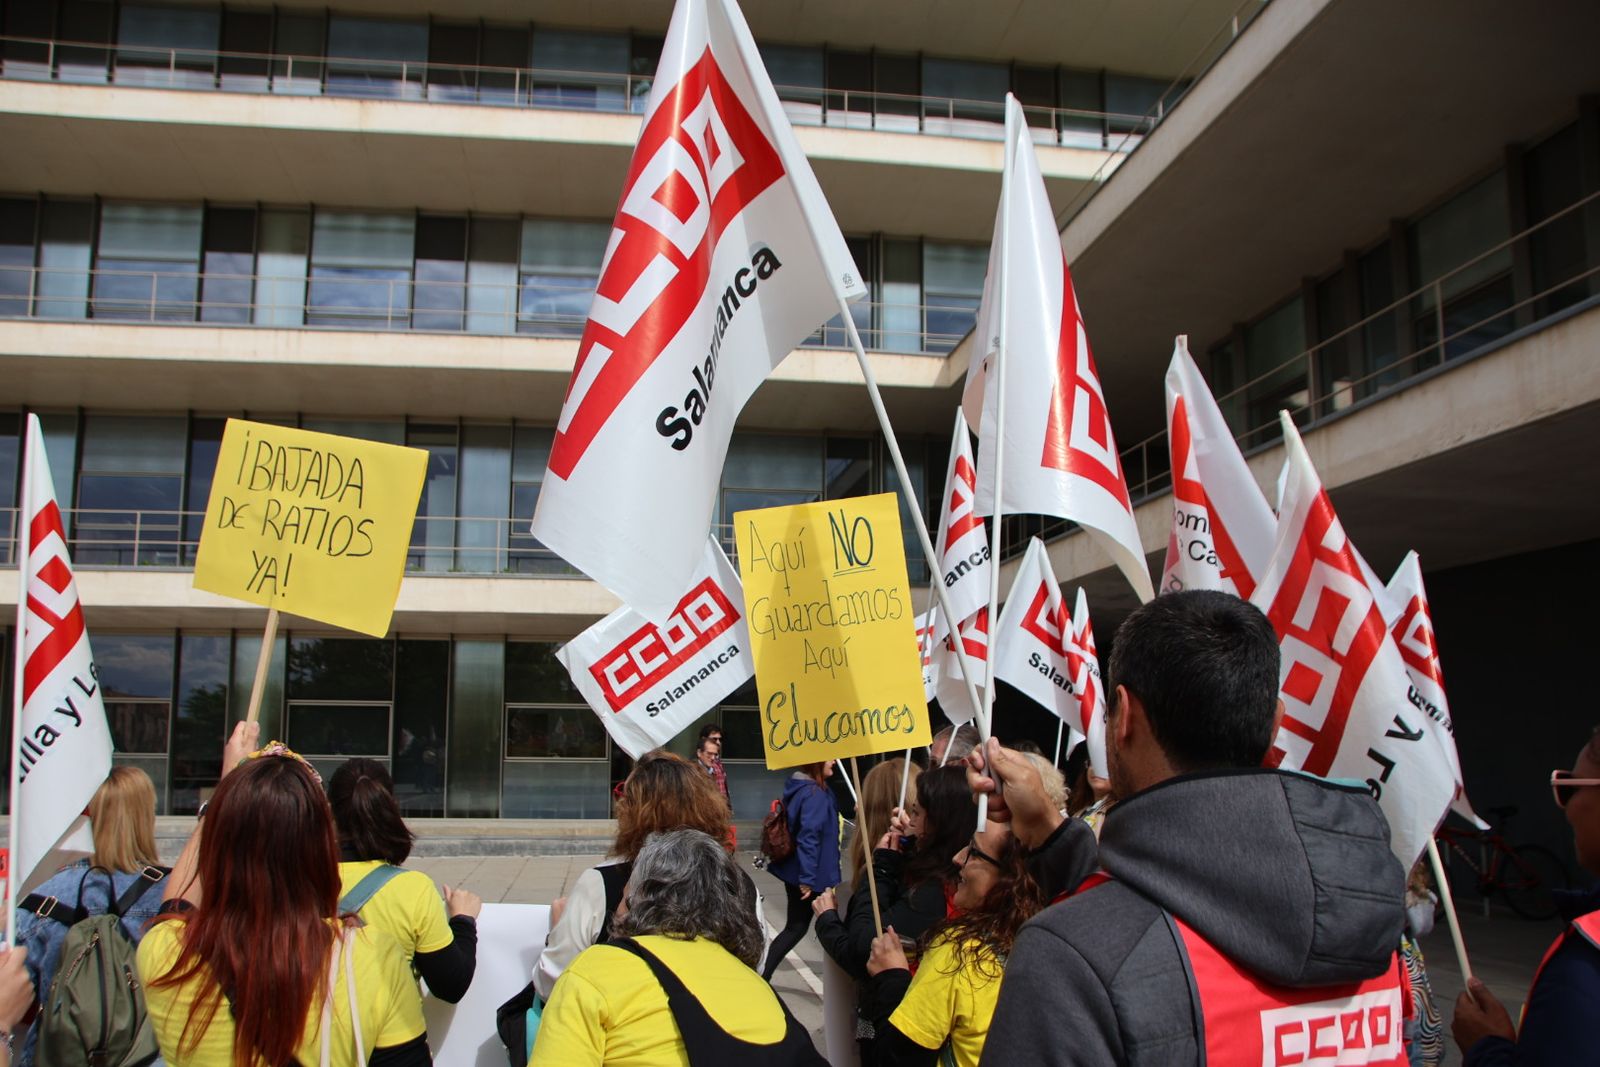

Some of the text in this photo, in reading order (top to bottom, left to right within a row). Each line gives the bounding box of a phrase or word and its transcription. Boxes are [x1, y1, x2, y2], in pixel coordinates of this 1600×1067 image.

[655, 246, 782, 451] Salamanca
[218, 496, 375, 557] DE RATIOS
[749, 509, 874, 597] Aquí NO
[246, 550, 293, 598] YA!
[751, 579, 903, 640] Guardamos
[602, 590, 727, 698] CCOO
[804, 636, 851, 679] Aquí
[54, 696, 82, 727] y
[645, 644, 740, 718] Salamanca
[766, 682, 915, 751] Educamos
[1275, 1005, 1392, 1067] CCOO
